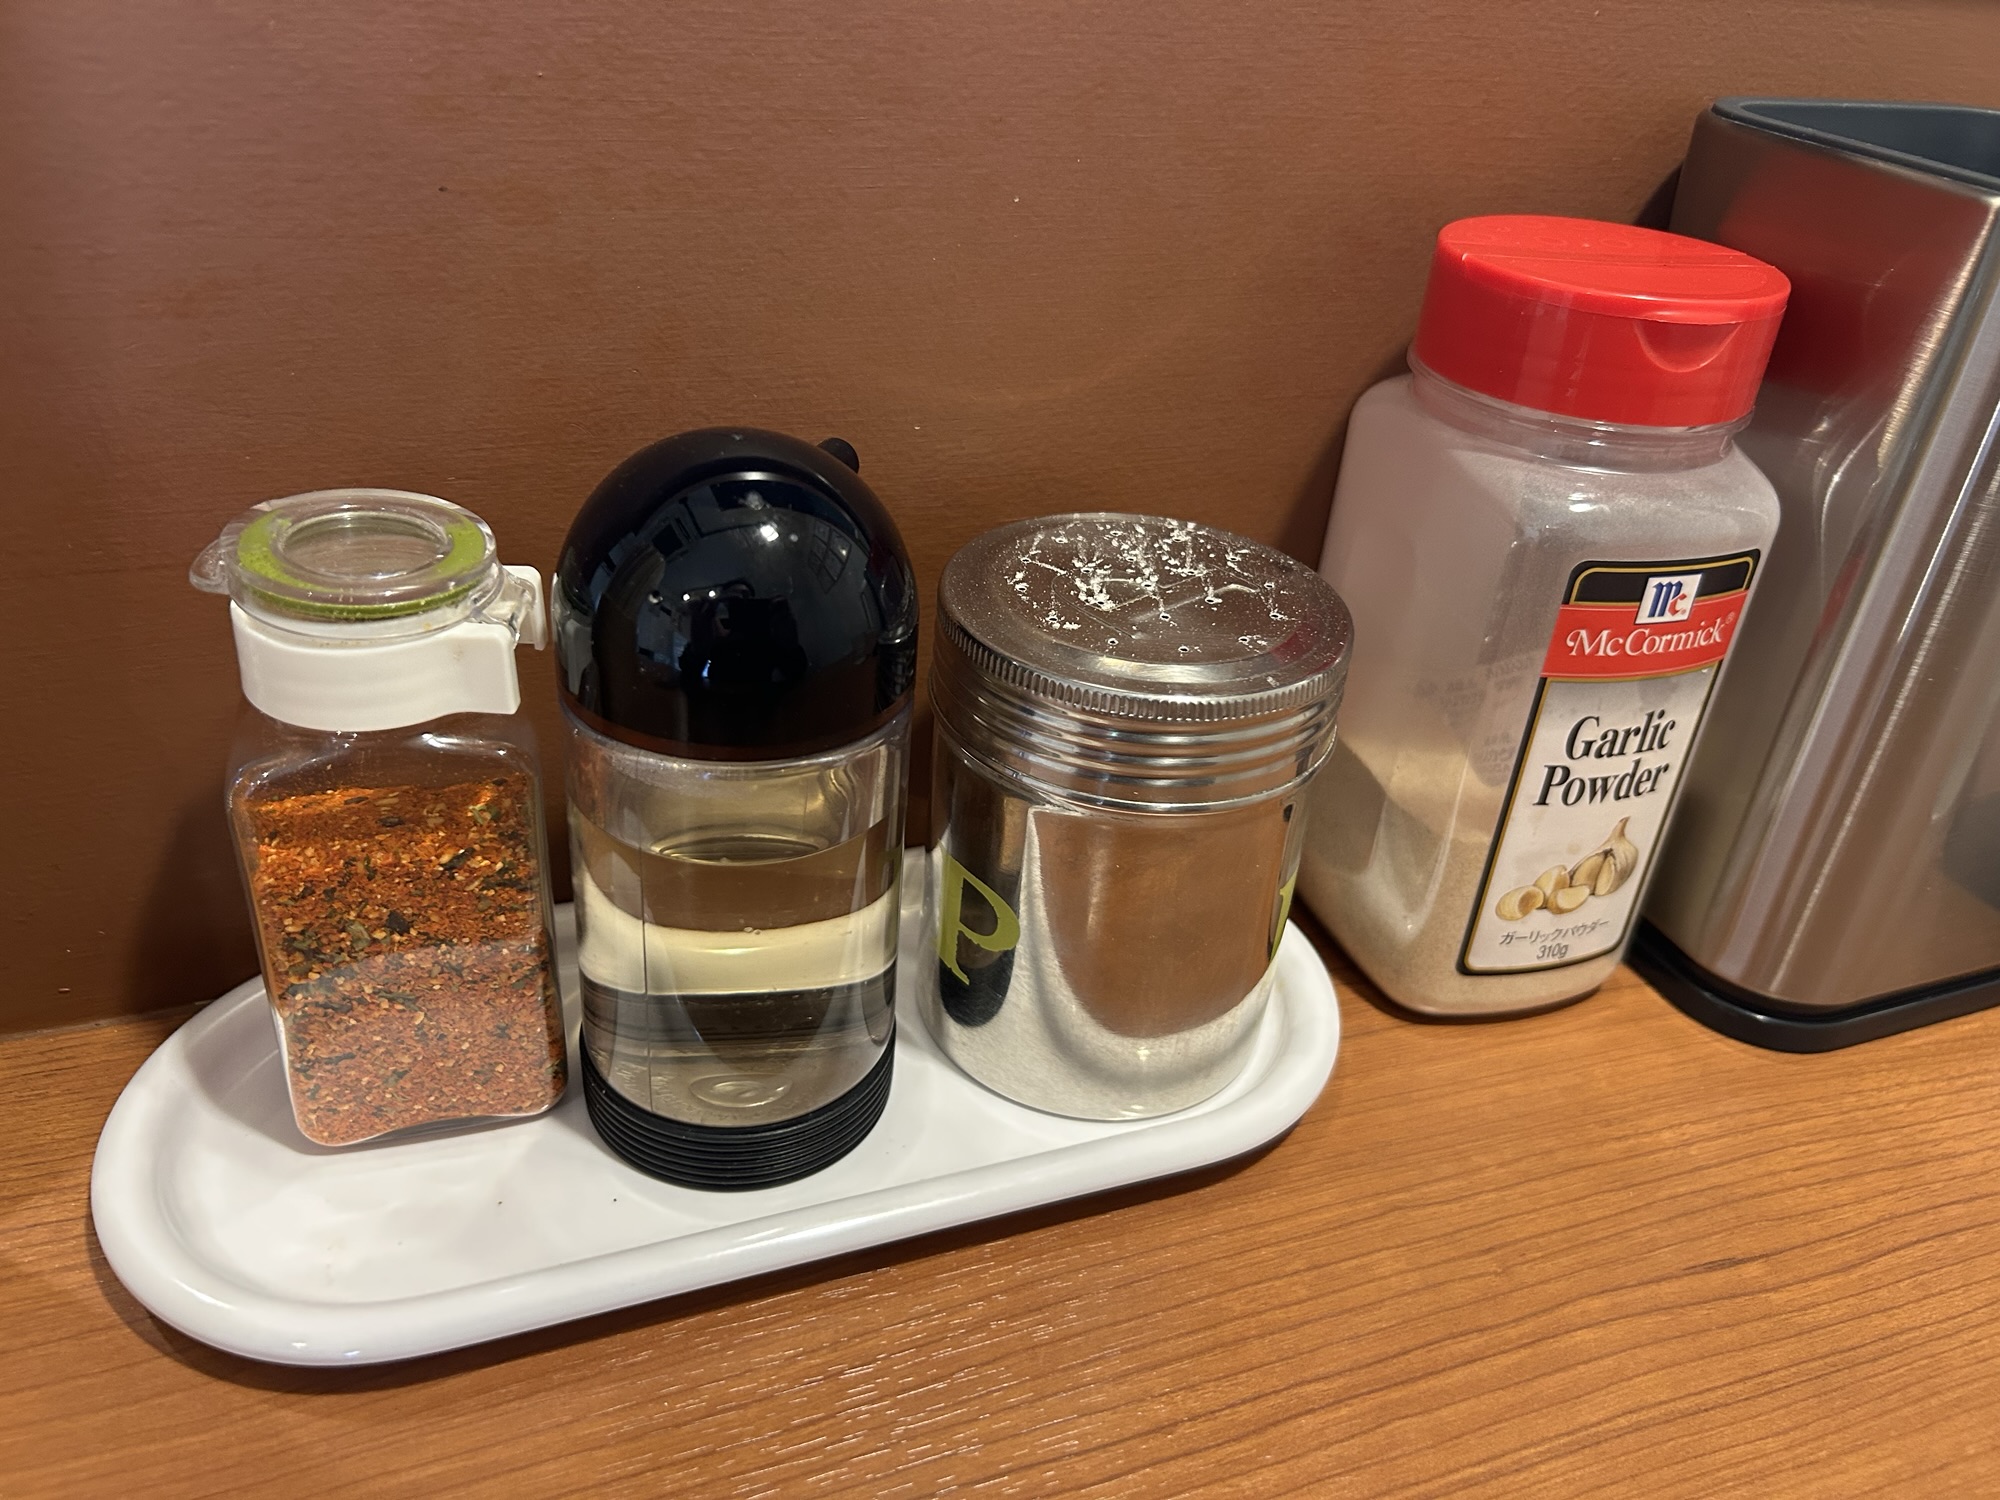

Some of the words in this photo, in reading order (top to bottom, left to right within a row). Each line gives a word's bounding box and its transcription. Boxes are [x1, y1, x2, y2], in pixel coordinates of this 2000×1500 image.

[1565, 709, 1676, 760] Garlic
[1532, 757, 1670, 806] Powder
[1499, 918, 1609, 945] ガーリックパウダー
[1536, 942, 1569, 960] 310g
